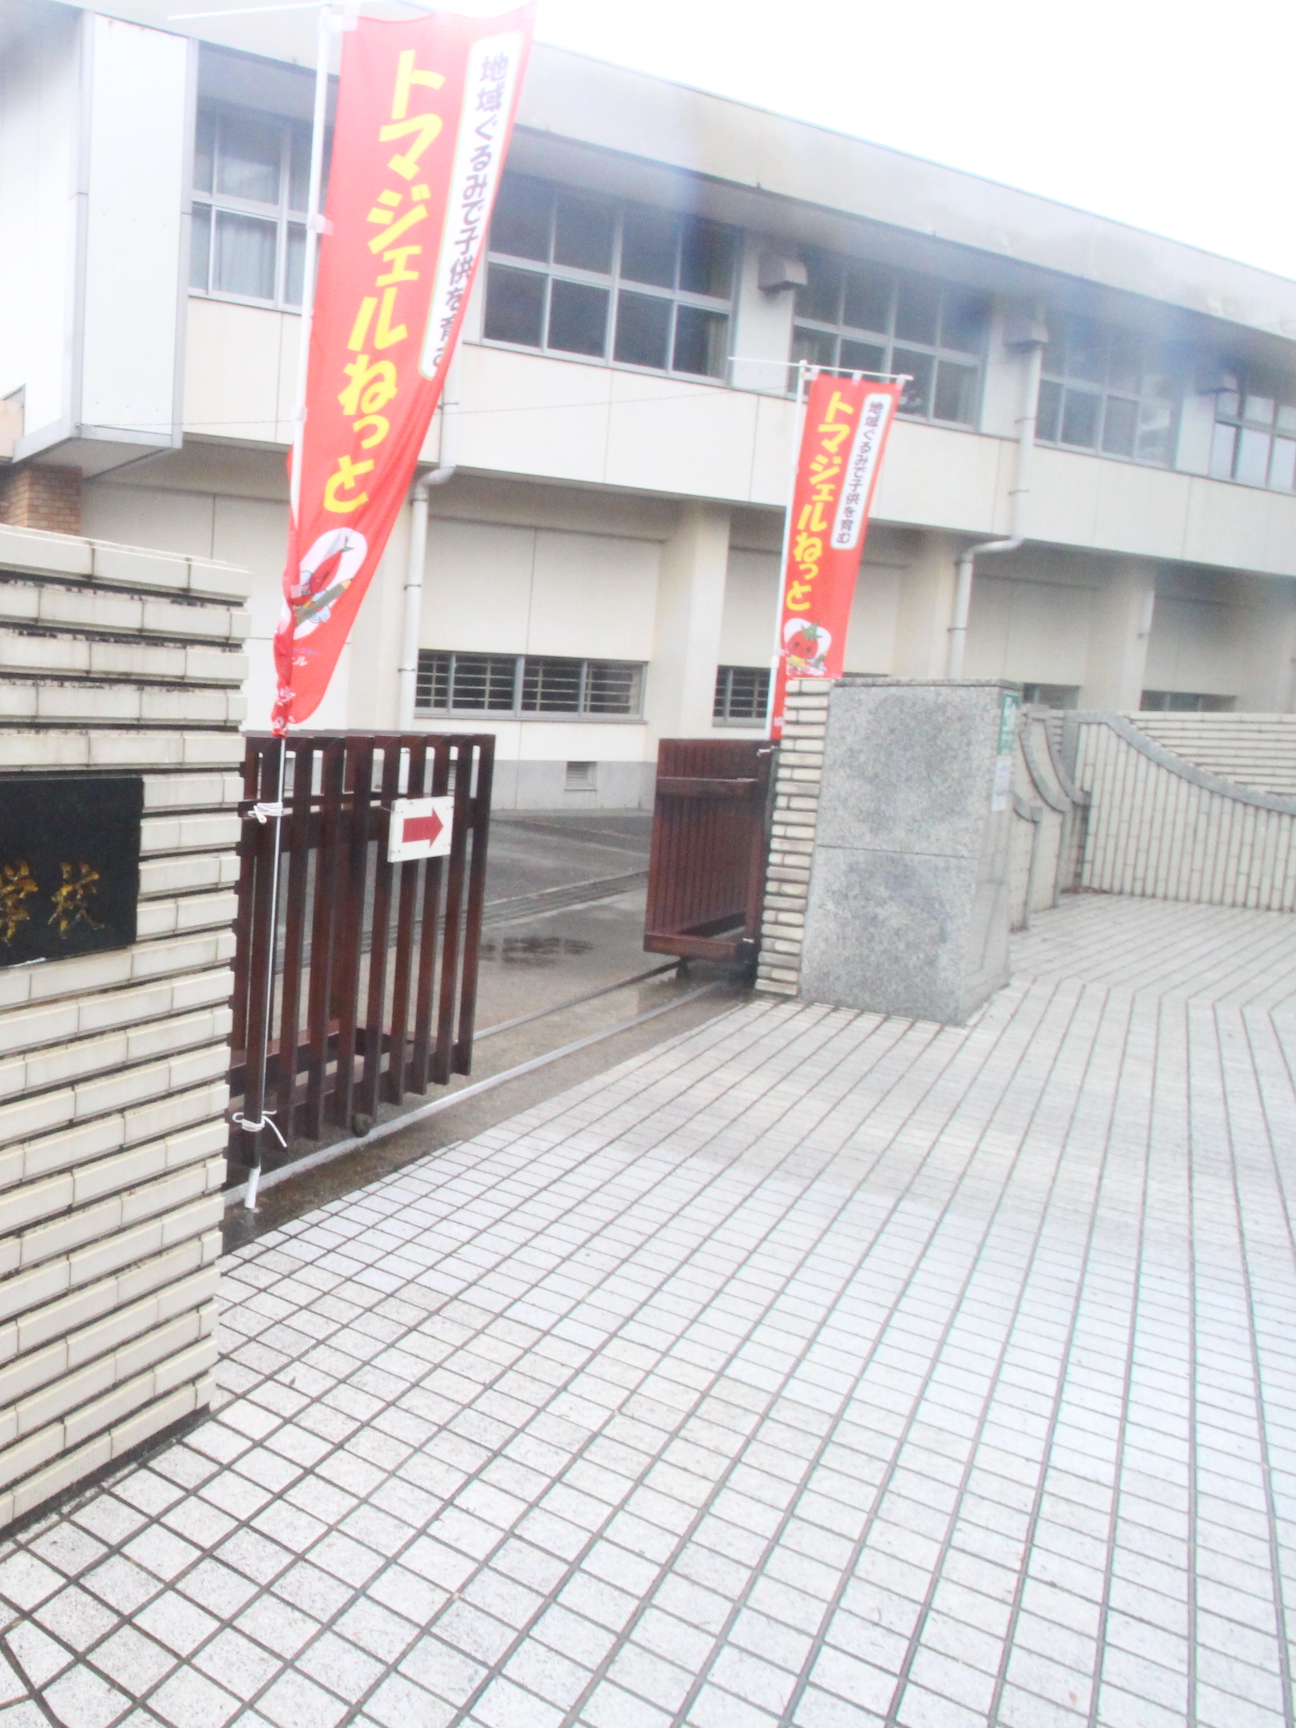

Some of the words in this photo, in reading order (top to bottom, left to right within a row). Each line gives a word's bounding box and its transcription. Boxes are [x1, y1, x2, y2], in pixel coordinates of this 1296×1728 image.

[322, 49, 445, 514] トマジェルねっと
[785, 391, 855, 612] トマジェルねっと
